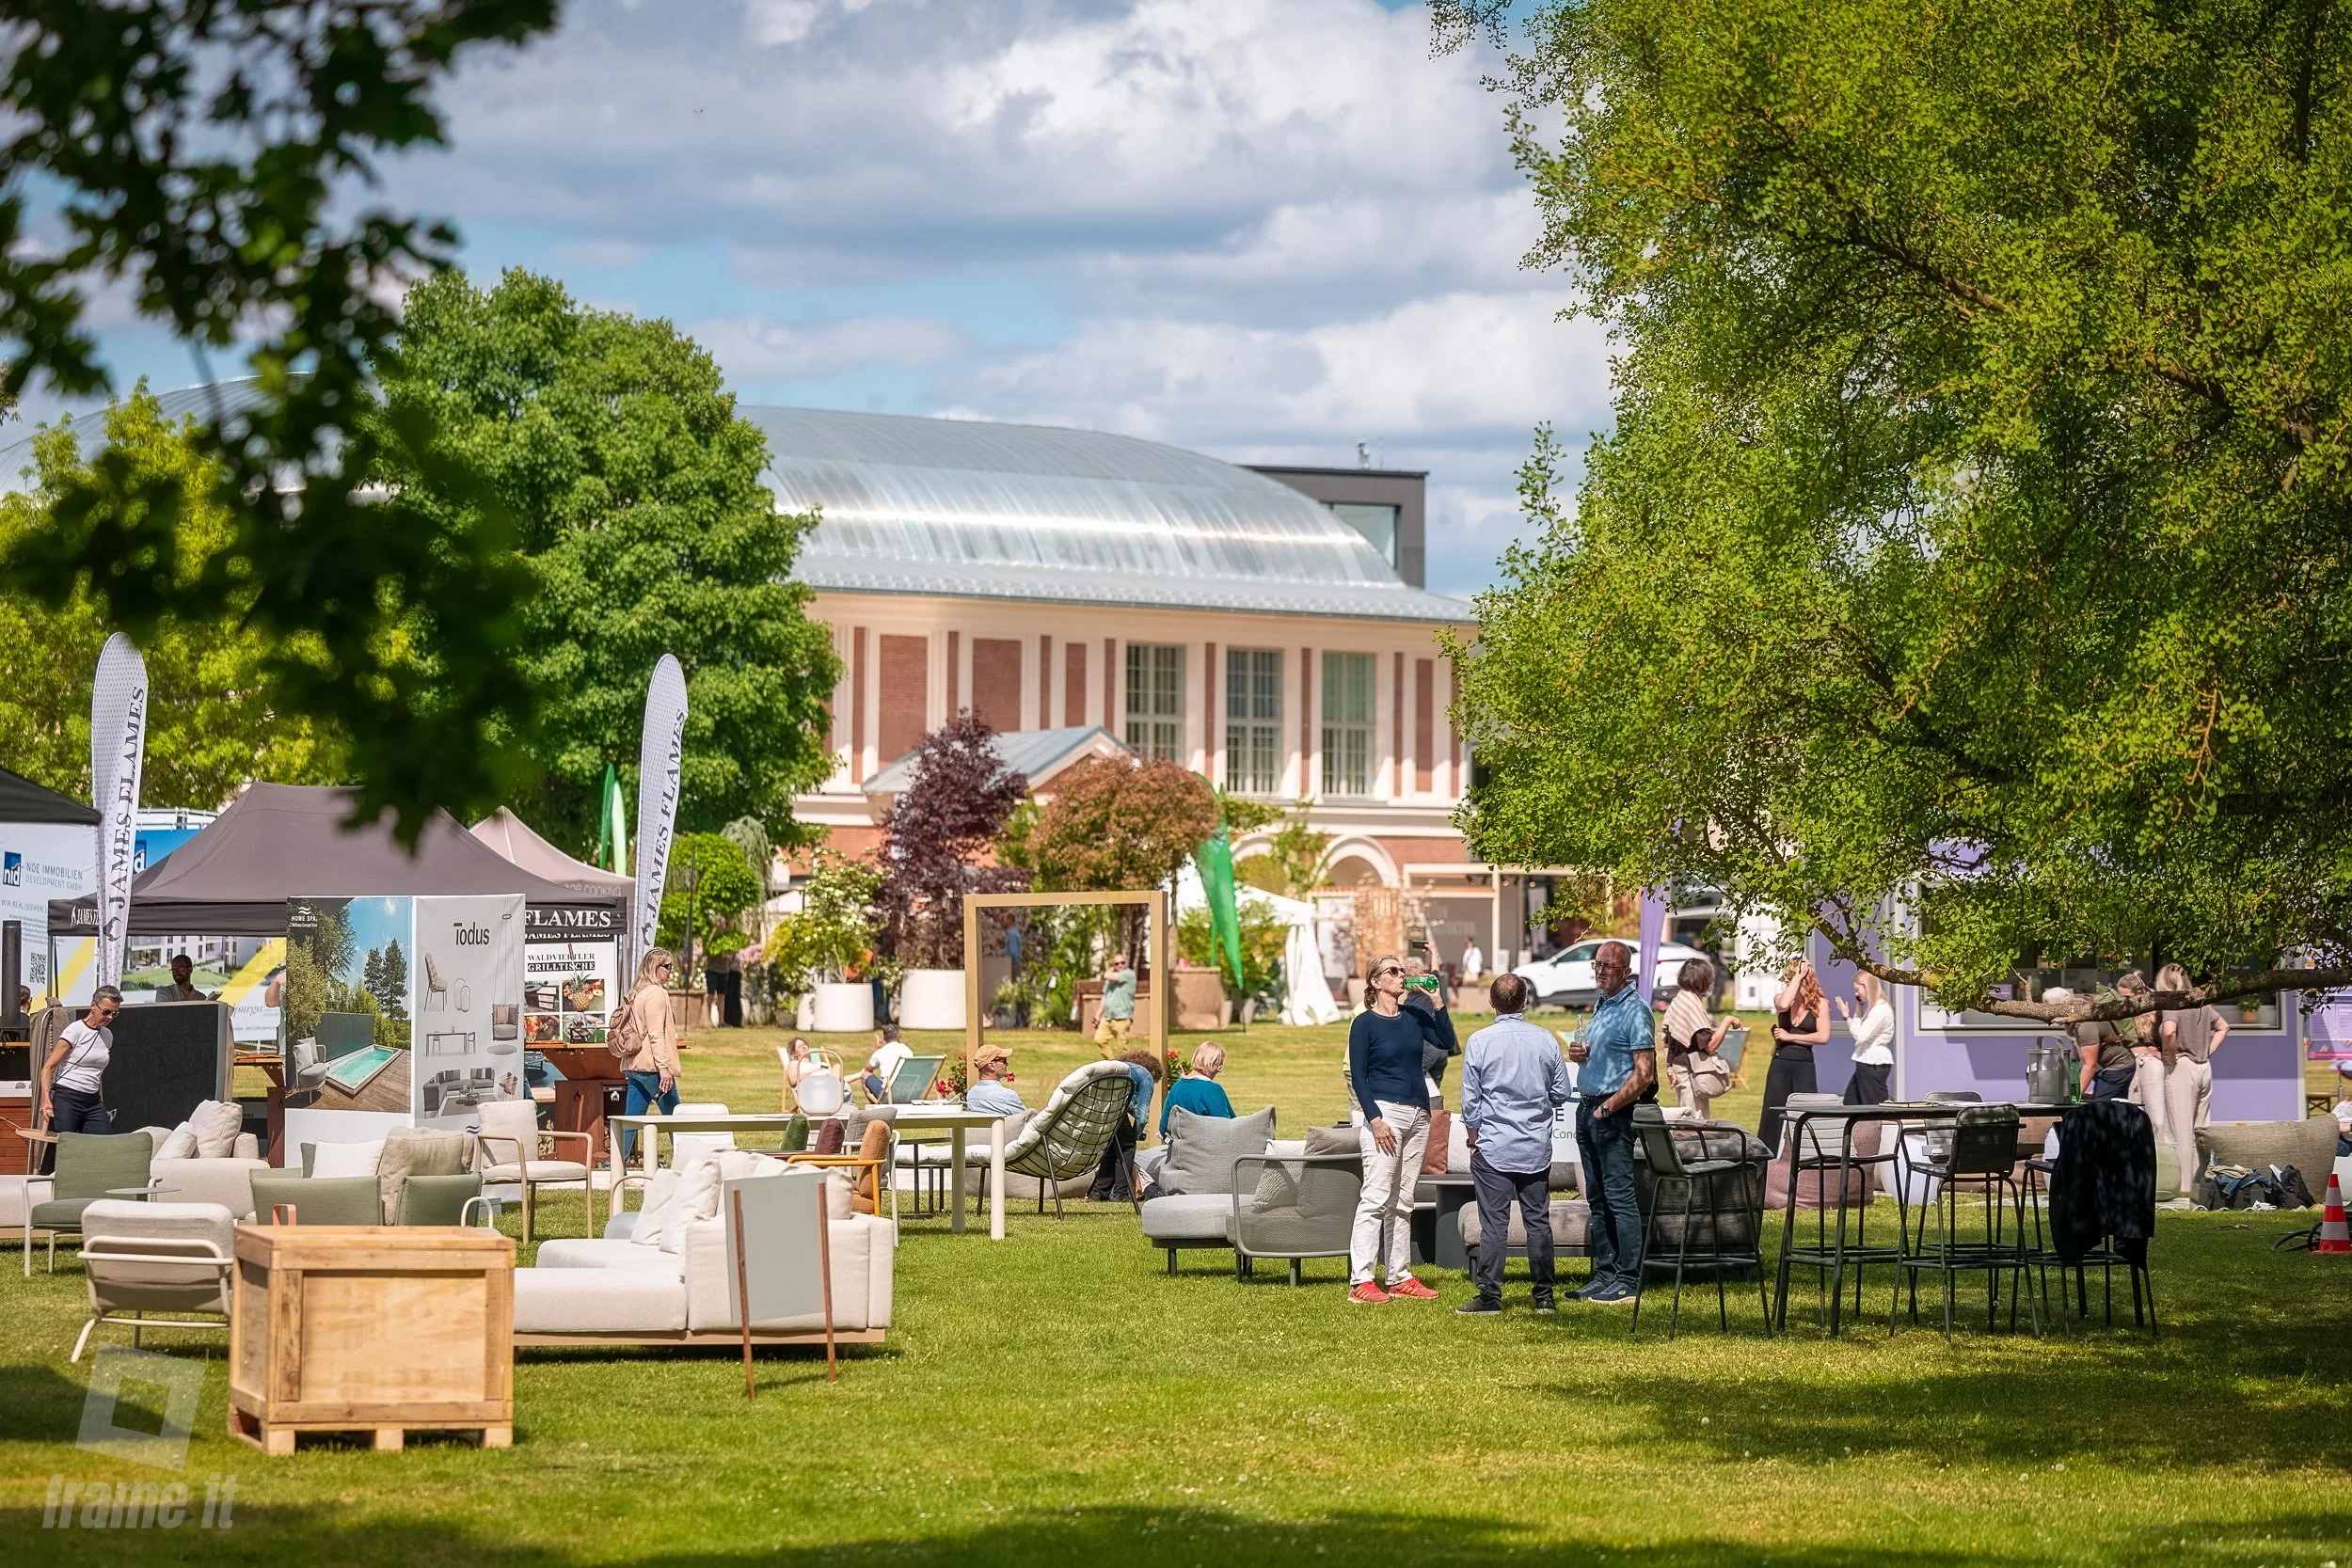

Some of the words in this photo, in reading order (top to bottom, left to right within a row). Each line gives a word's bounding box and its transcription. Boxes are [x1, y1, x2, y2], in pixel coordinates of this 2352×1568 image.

[119, 687, 145, 804] FLAMES
[647, 824, 669, 918] JAMES
[660, 709, 685, 818] FLAMES
[108, 812, 132, 910] JAMES
[4, 865, 21, 886] nid
[25, 875, 65, 888] DEVELOPMENT
[42, 864, 83, 880] IMMOBILIEN
[525, 910, 612, 927] FLAMES
[528, 962, 596, 972] GRILLTISCHE
